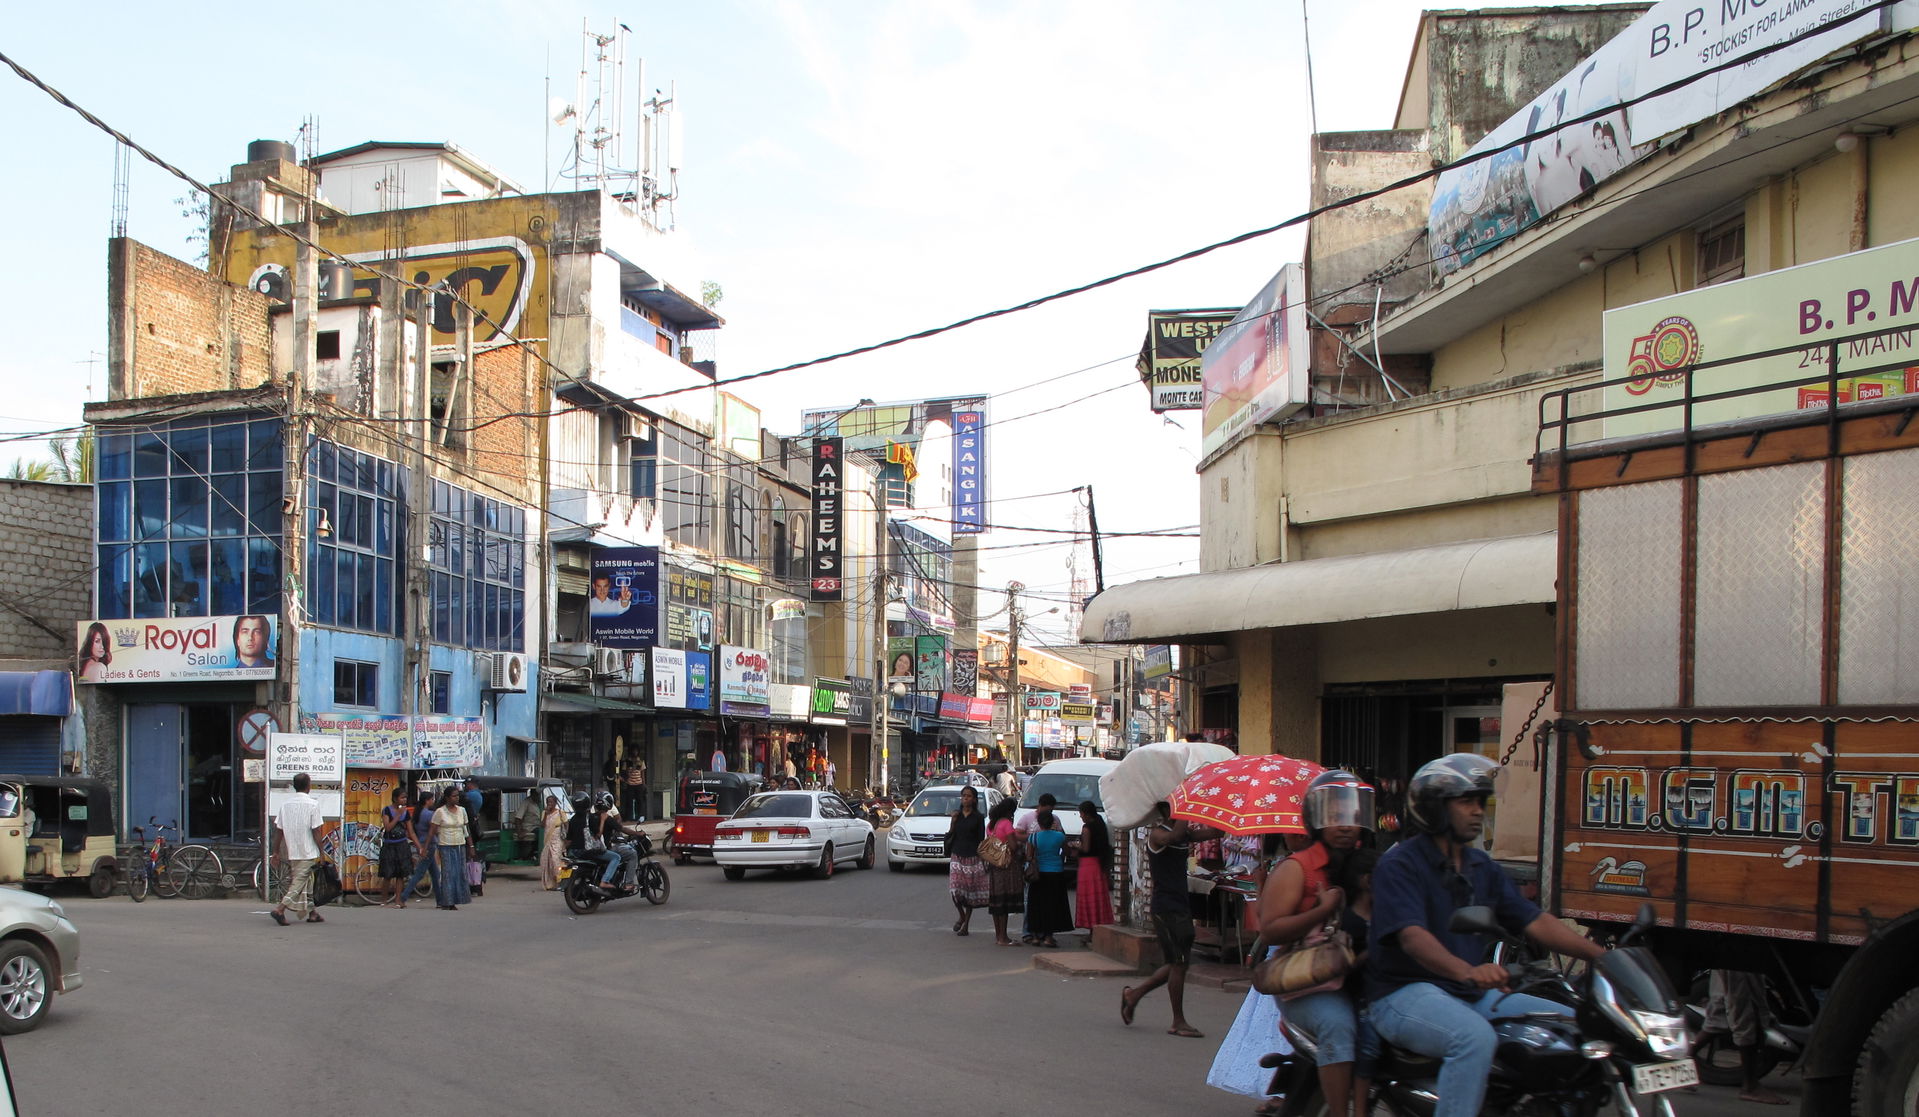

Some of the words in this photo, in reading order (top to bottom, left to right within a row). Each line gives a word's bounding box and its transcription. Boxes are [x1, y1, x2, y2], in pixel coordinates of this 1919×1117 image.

[1755, 15, 1777, 39] FOR
[1799, 299, 1834, 335] B.
[1847, 288, 1876, 326] P.
[1662, 317, 1680, 328] YEARS
[1680, 318, 1689, 327] OF
[1849, 330, 1912, 359] MAIN
[1159, 391, 1187, 405] MONTE
[961, 425, 976, 530] ASANGIKA
[816, 444, 837, 570] RAHEEMS
[595, 560, 632, 568] SAMSUNG
[817, 579, 836, 590] 23
[144, 622, 217, 654] Royal
[187, 653, 227, 666] Salon
[655, 655, 668, 664] ASWIN
[668, 656, 683, 666] MOBILE
[100, 670, 127, 679] Ladies
[128, 669, 134, 678] &
[136, 668, 161, 678] Gents
